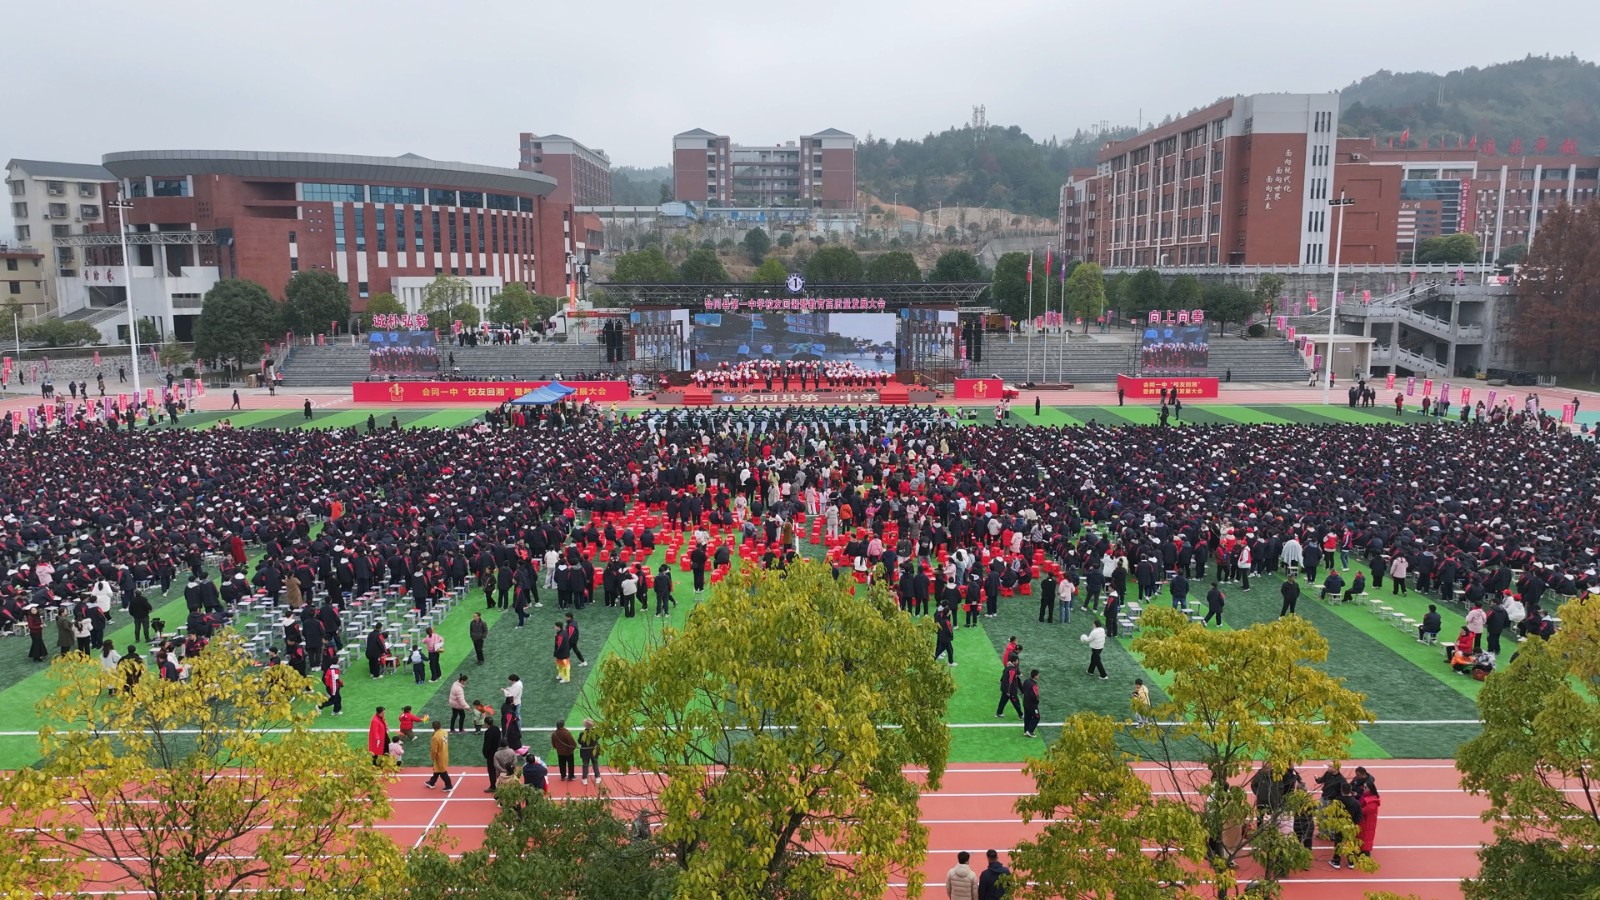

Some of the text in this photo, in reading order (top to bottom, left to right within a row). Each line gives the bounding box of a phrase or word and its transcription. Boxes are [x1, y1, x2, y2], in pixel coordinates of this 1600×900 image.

[1274, 167, 1283, 201] 面向世界
[373, 313, 429, 328] 诚朴弘毅
[1148, 309, 1204, 324] 向上向善
[739, 393, 879, 403] 会同县第一中学
